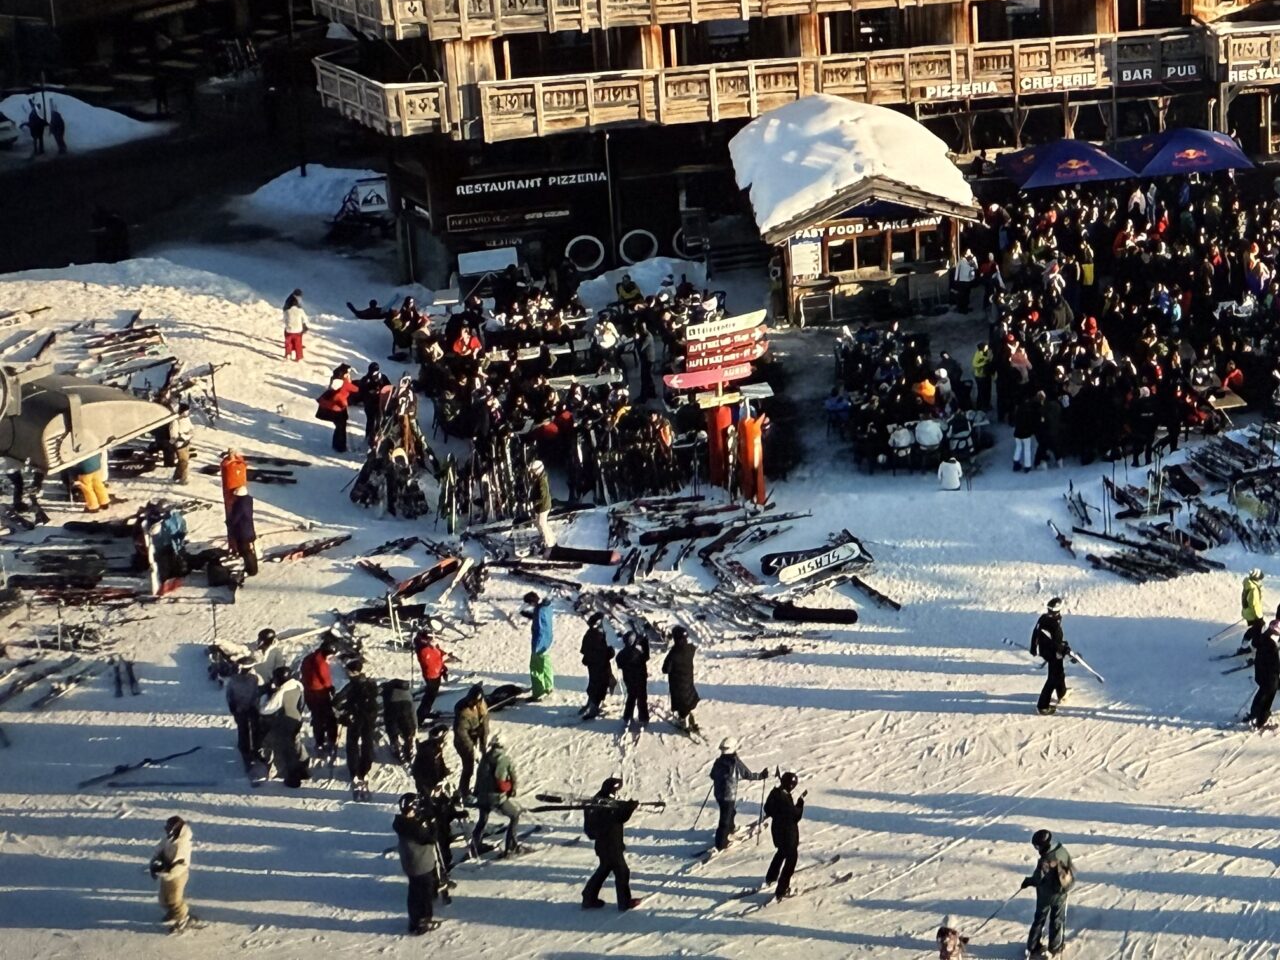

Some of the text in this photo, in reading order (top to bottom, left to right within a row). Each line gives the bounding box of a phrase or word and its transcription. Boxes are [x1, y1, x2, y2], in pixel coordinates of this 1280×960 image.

[1020, 73, 1097, 90] CREPERIE
[1122, 65, 1197, 81] BAR PUB
[925, 81, 998, 99] PIZZERIA
[456, 171, 607, 195] RESTAURANT PIZZERIA
[795, 227, 825, 239] FAST
[828, 223, 864, 236] FOOD
[877, 218, 909, 231] TAKE
[912, 215, 943, 227] AWAY
[797, 551, 840, 575] SLASH
